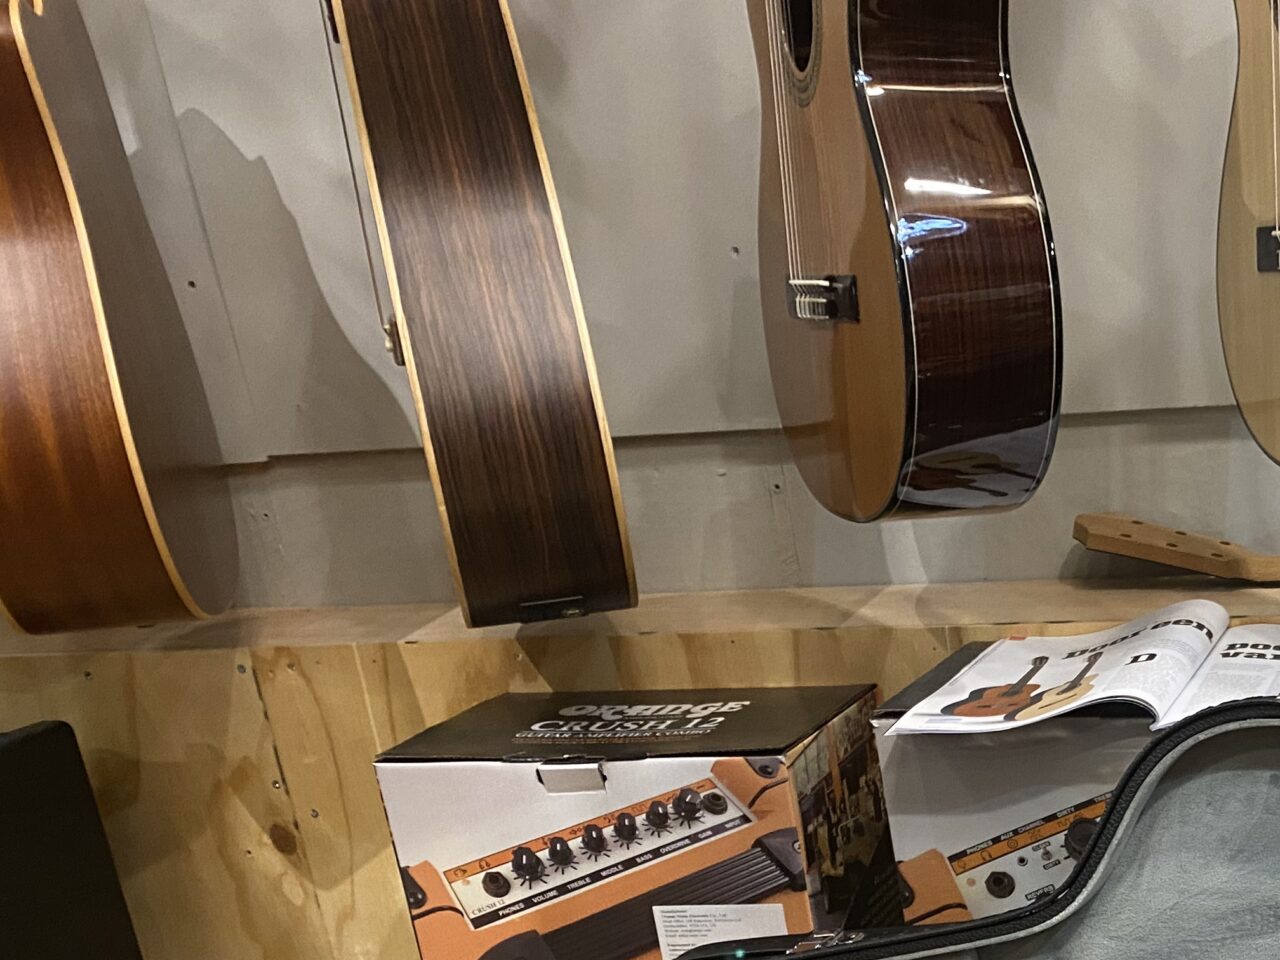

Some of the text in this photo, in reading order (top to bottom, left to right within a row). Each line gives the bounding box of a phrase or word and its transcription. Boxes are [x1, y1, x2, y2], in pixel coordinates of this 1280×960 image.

[1150, 619, 1213, 642] een
[559, 701, 750, 720] ORANGE
[530, 716, 725, 731] CRUSH 12
[498, 903, 525, 916] PHONES
[532, 890, 558, 903] VOLUME
[567, 877, 591, 890] TREBLE
[600, 864, 624, 877] MIDDLE
[636, 854, 653, 863] BASS
[660, 839, 692, 854] OVERDRIVE
[472, 902, 496, 915] CRUSH
